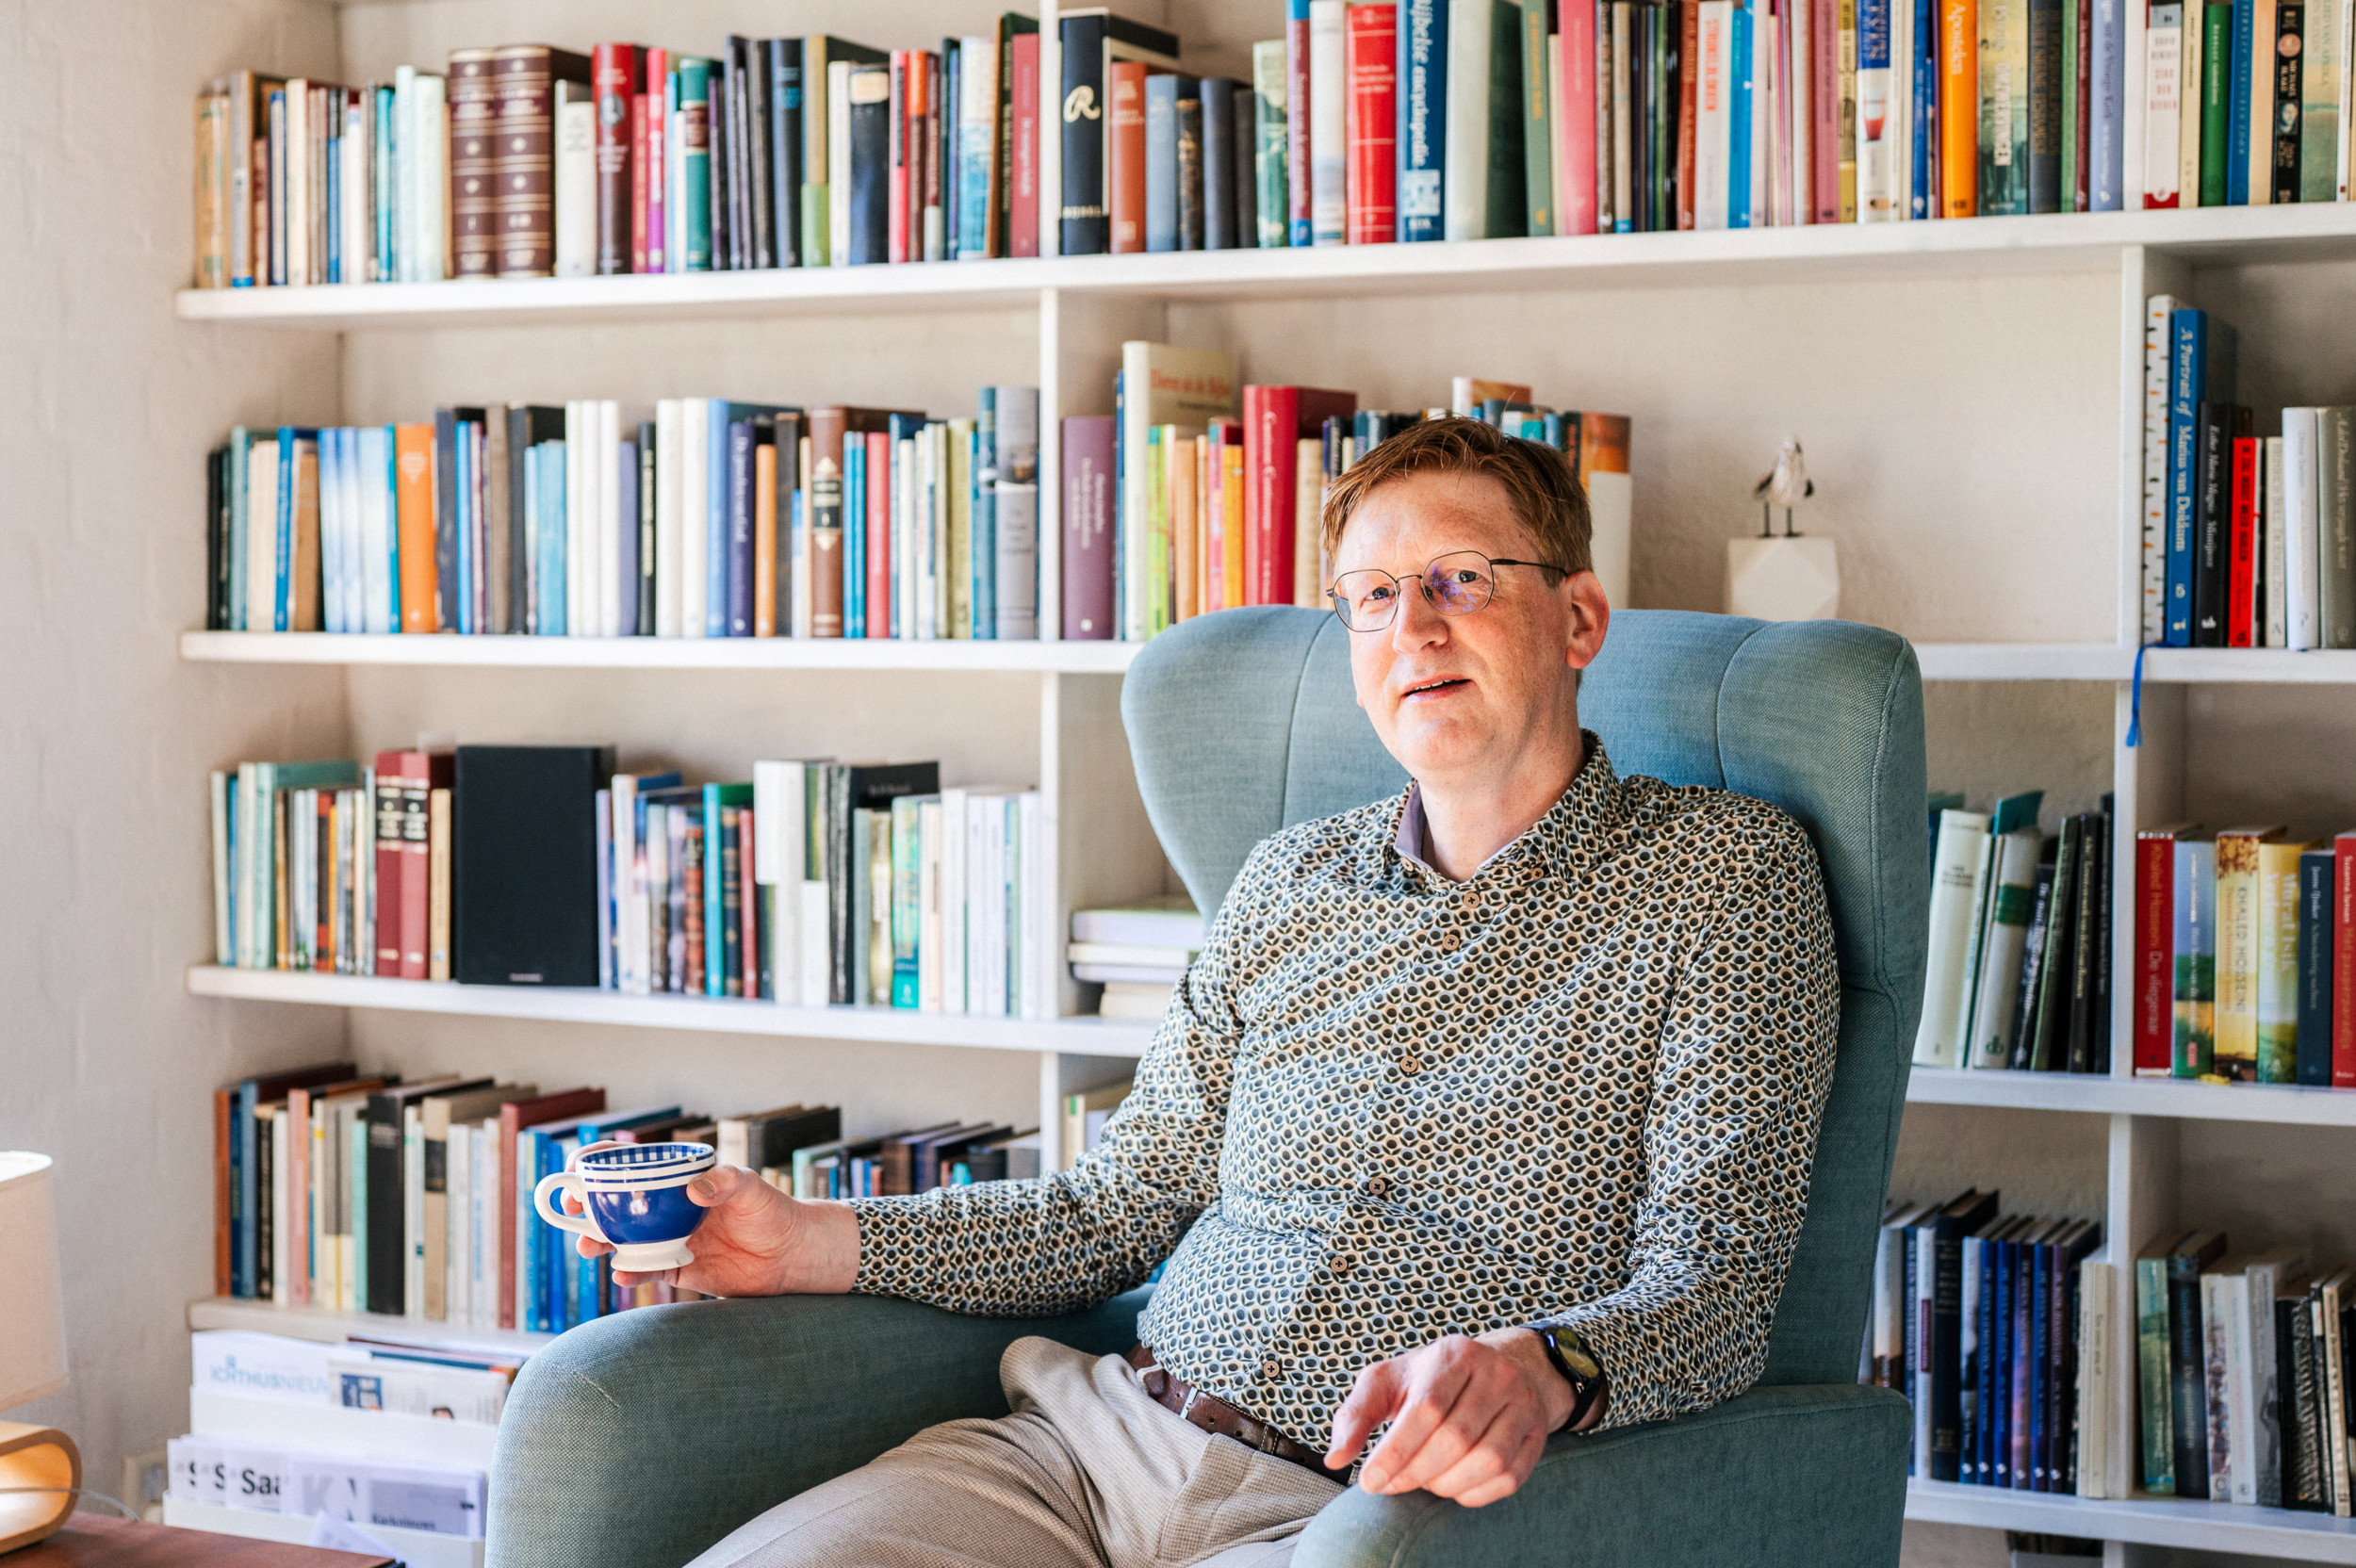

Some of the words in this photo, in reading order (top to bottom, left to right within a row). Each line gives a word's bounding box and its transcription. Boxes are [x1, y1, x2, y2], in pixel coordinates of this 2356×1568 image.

[1409, 66, 1429, 167] encyclopedie
[2180, 326, 2194, 342] A
[2179, 344, 2193, 400] Portrait
[2175, 401, 2193, 417] of
[2177, 426, 2192, 469] Marius
[2177, 471, 2188, 493] van
[2175, 496, 2191, 552] Dokkum
[2149, 843, 2164, 890] Khaled
[2149, 893, 2164, 947] Hosseini
[2234, 886, 2250, 939] KHALED
[2282, 872, 2298, 929] Murat
[2149, 951, 2163, 972] De
[2282, 936, 2297, 972] Isik
[2342, 927, 2354, 951] Het
[2145, 973, 2164, 1035] vliegeraar
[2234, 945, 2250, 1014] HOSSEINI
